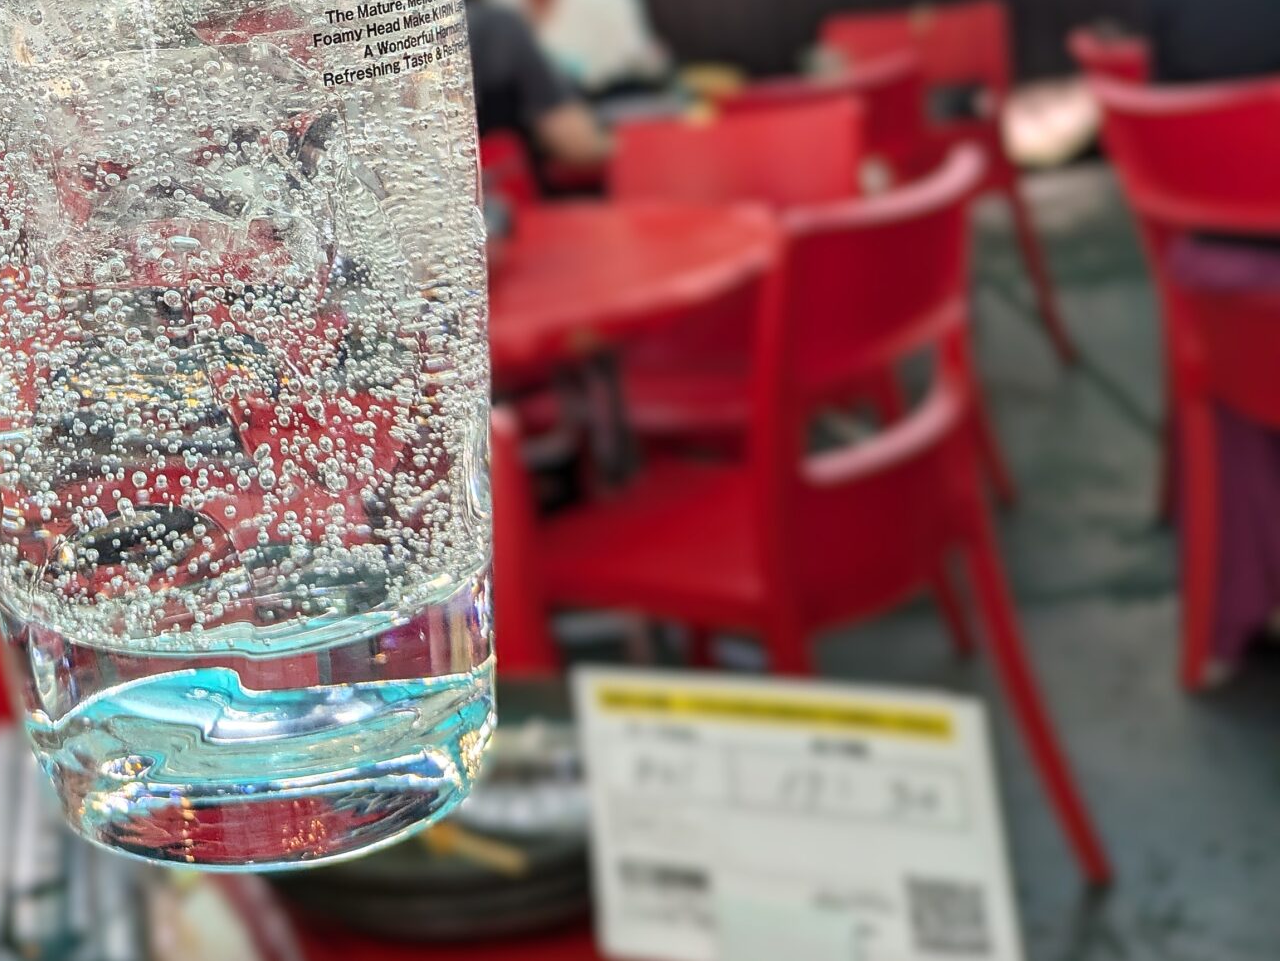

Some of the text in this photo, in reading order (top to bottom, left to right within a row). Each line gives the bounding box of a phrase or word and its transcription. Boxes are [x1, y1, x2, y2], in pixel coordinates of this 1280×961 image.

[313, 28, 362, 48] Foamy
[366, 20, 401, 38] Head
[403, 13, 431, 29] Make
[432, 2, 454, 21] KIRIN
[325, 9, 354, 24] The
[357, 0, 406, 18] Mature,
[363, 44, 374, 59] A
[377, 30, 434, 56] Wonderful
[323, 60, 400, 87] Refreshing
[403, 52, 434, 71] Taste
[435, 46, 443, 60] &
